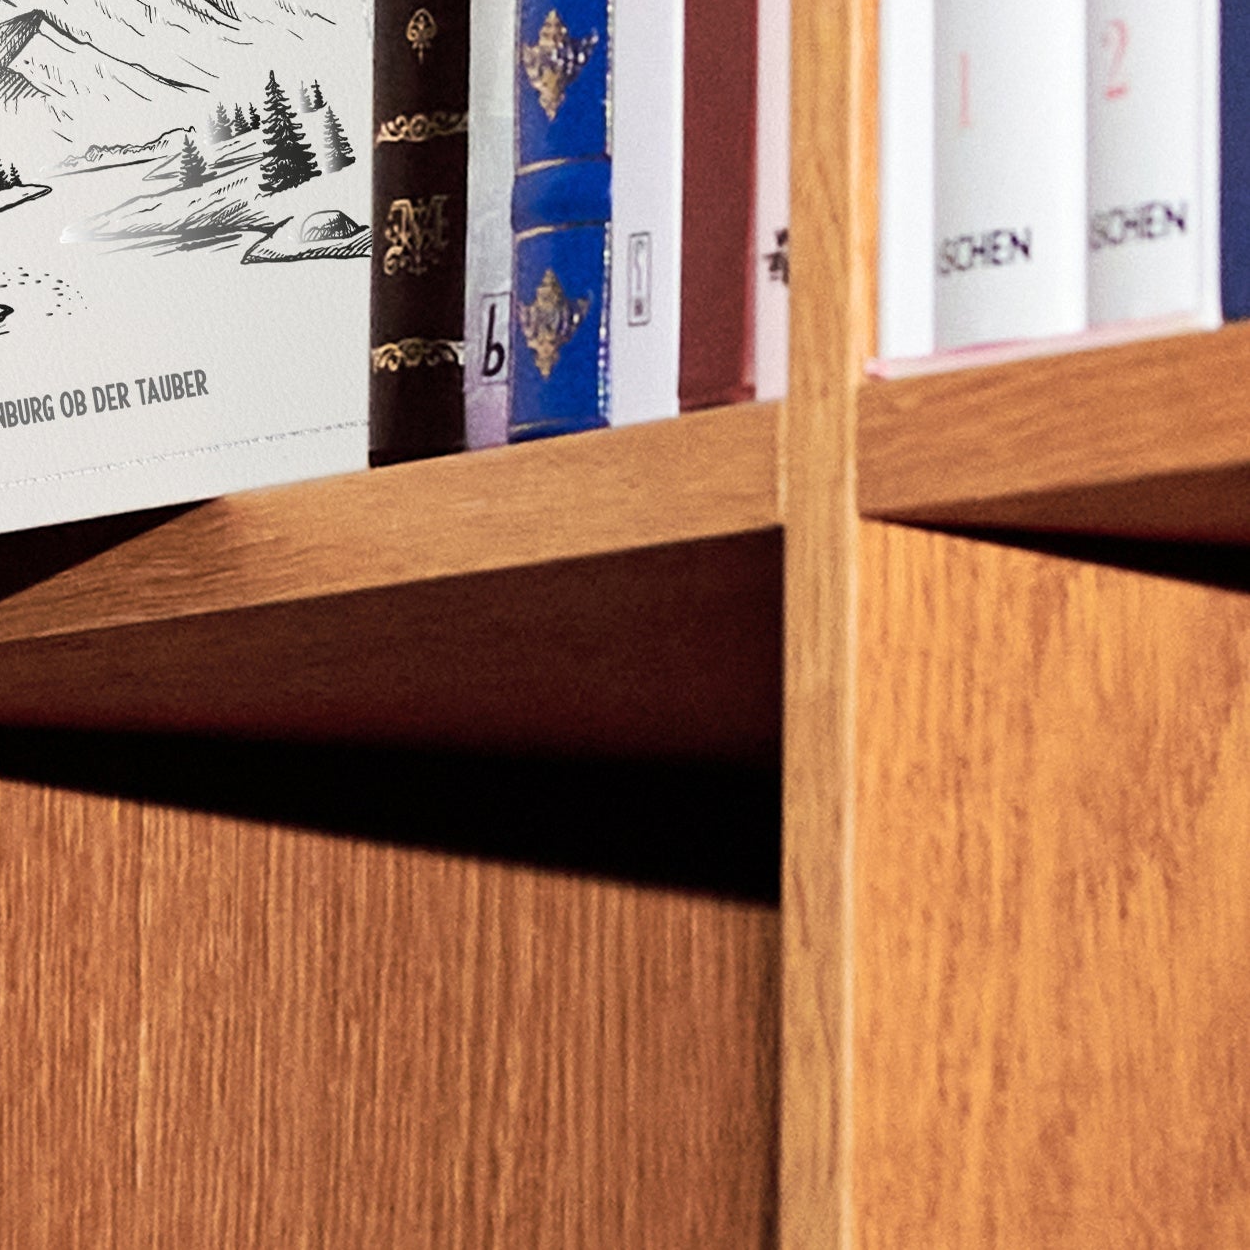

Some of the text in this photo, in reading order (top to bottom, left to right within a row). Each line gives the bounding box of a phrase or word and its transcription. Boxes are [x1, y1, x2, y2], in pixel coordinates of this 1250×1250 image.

[1103, 17, 1131, 102] 2
[482, 303, 506, 379] b
[59, 389, 88, 419] OB
[91, 382, 132, 414] DER
[134, 369, 210, 406] TAUBER
